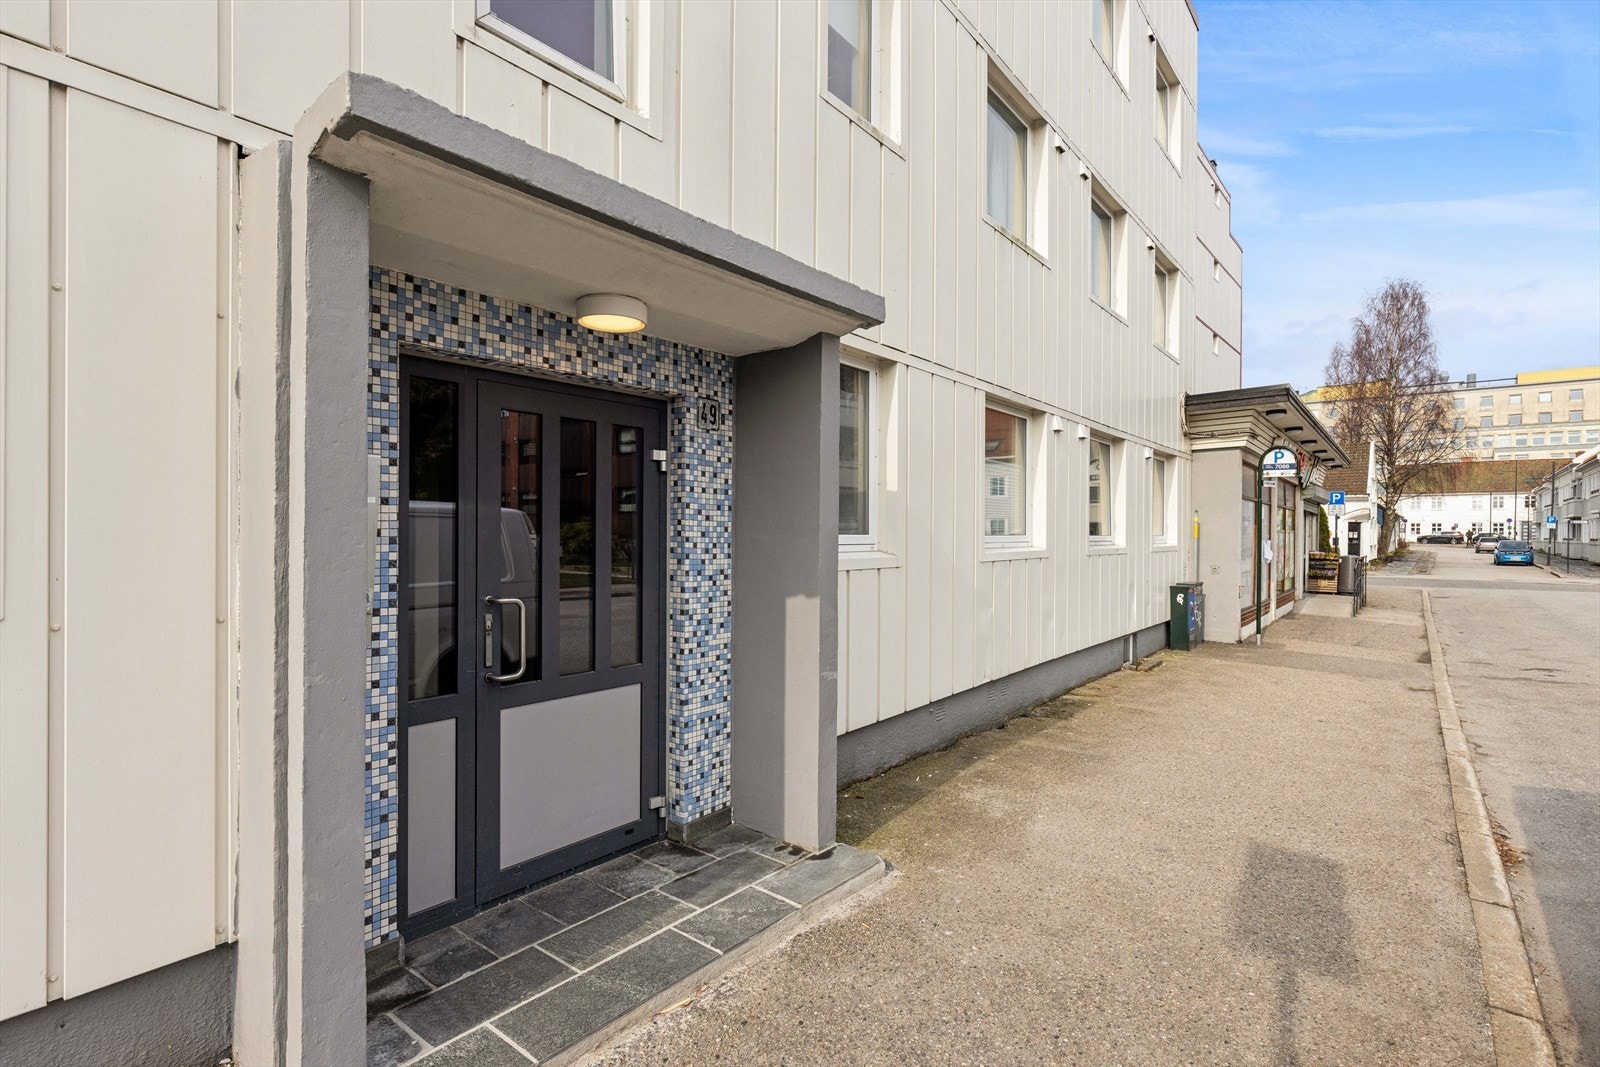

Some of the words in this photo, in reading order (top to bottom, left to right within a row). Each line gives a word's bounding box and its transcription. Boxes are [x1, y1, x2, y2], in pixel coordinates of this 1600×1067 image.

[701, 403, 717, 425] 49
[1274, 451, 1284, 463] P
[1332, 493, 1341, 503] P
